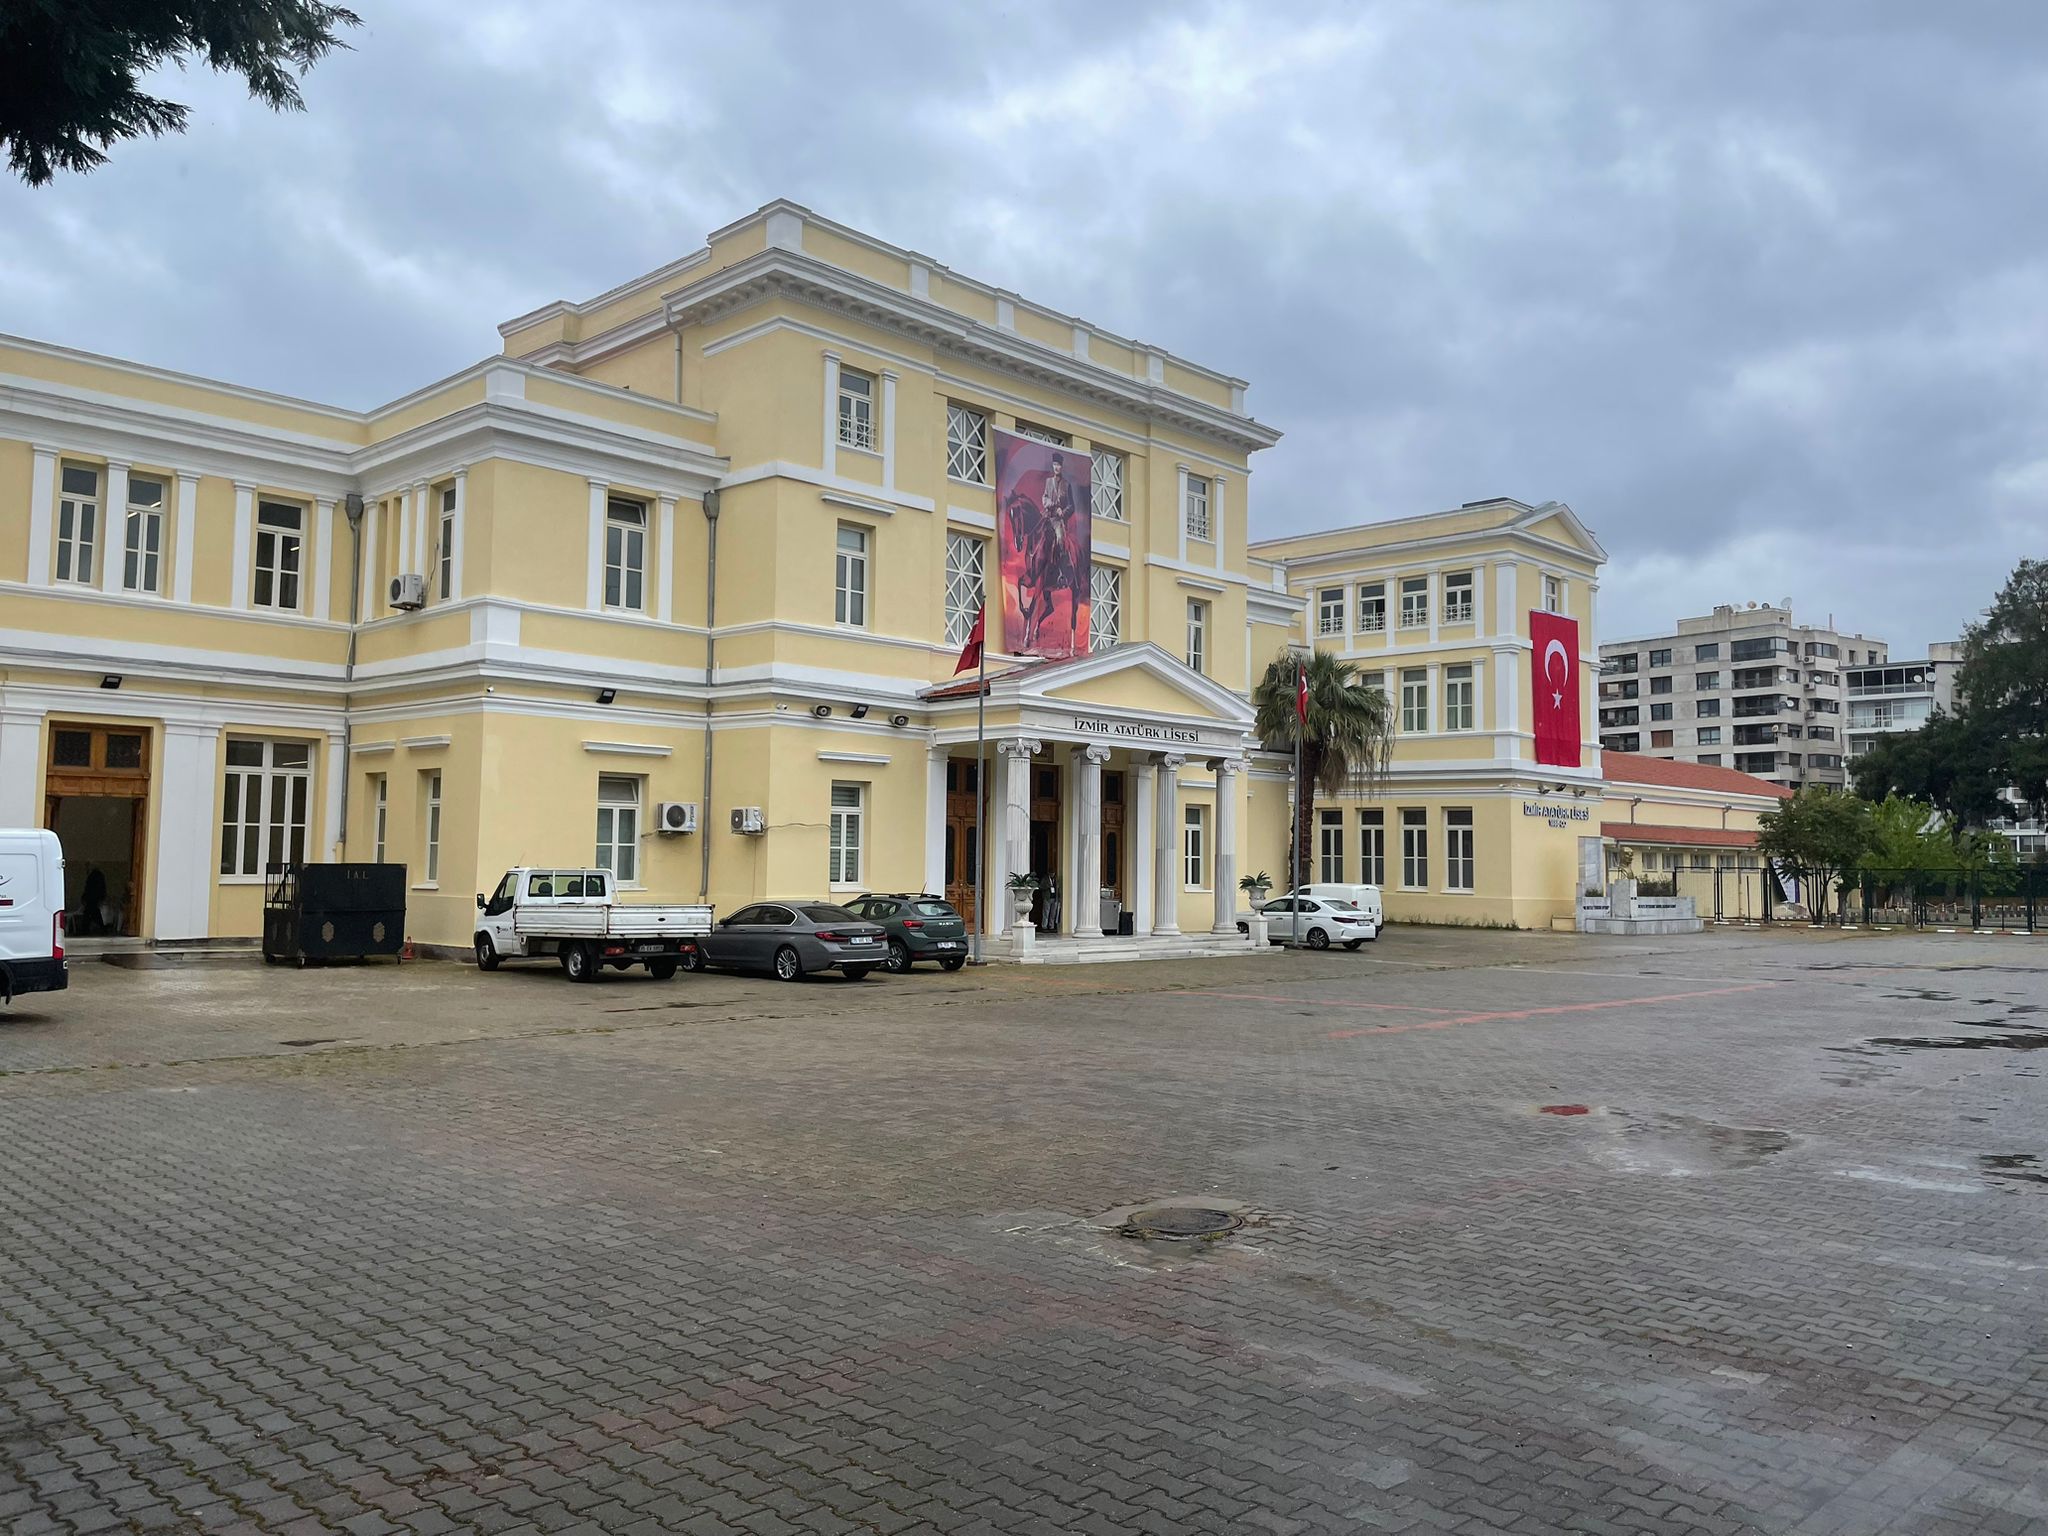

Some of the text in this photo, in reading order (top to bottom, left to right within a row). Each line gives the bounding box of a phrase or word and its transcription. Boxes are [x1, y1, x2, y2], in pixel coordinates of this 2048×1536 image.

[1074, 717, 1199, 742] İZMİR ATATÜRK LİSESİ
